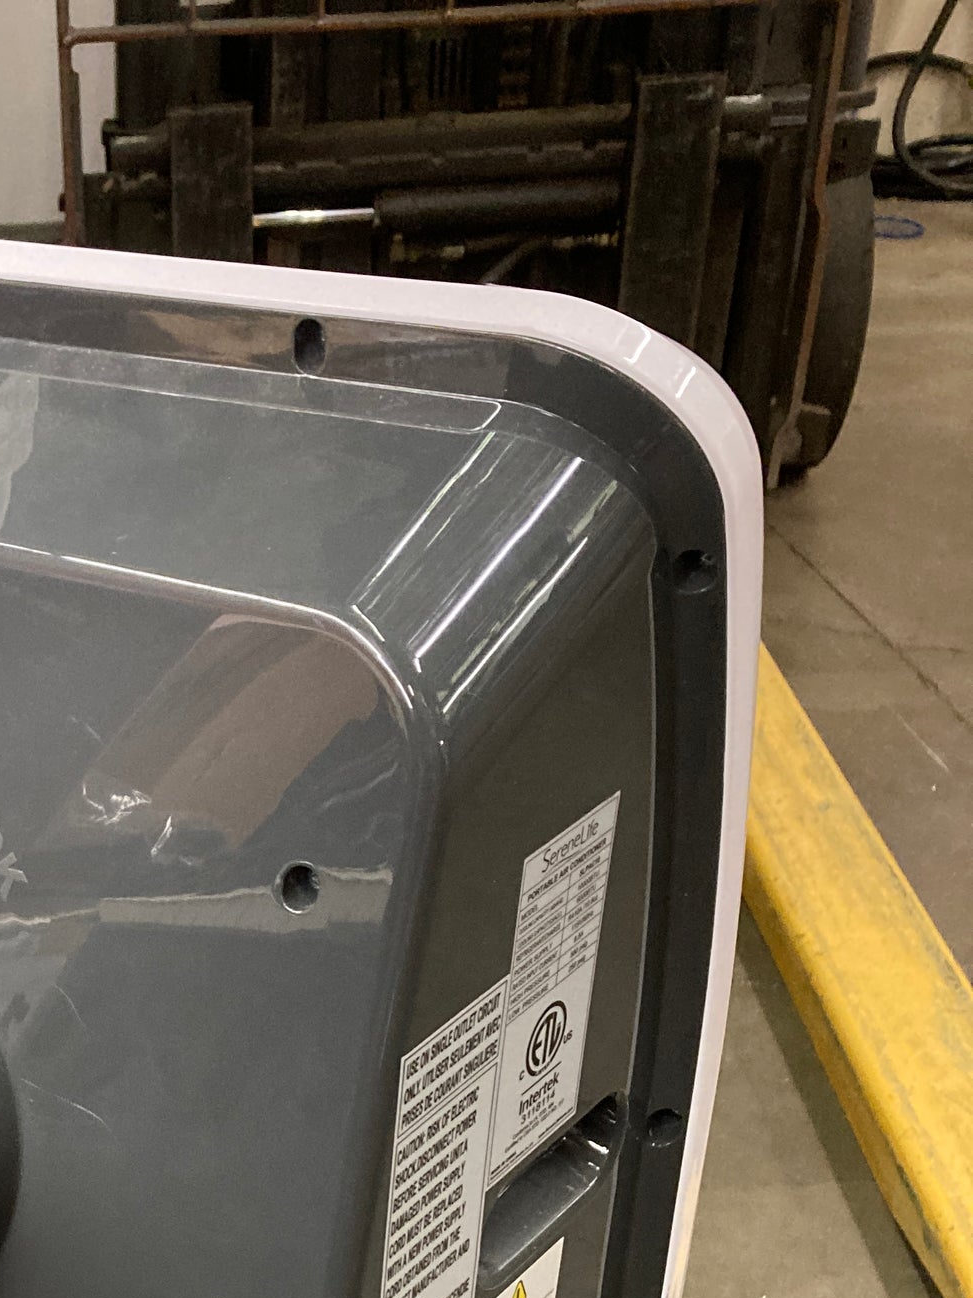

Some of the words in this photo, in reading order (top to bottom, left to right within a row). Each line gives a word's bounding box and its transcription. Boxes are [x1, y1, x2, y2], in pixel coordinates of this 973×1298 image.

[527, 873, 557, 901] PORTABLE
[558, 866, 568, 878] AIR
[569, 837, 606, 869] CONDITIONER
[541, 819, 598, 872] SereneLife
[514, 958, 532, 975] POWER
[533, 943, 552, 961] SUPPLY
[523, 970, 549, 993] PRESSURE
[522, 983, 548, 1008] PRESSURE
[406, 1056, 419, 1079] USE
[420, 1050, 429, 1068] ON
[430, 1030, 452, 1060] SINGLE
[453, 1011, 476, 1041] OUTLET
[477, 992, 500, 1022] CIRCUIT
[422, 1056, 449, 1089] UTILISER
[449, 1027, 484, 1067] SEULEMENT
[484, 1014, 501, 1038] AVEC
[563, 1029, 572, 1044] US
[401, 1099, 423, 1128] PRISES
[424, 1091, 433, 1111] DE
[433, 1067, 462, 1102] COURANT
[426, 1119, 440, 1139] RISK
[441, 1109, 450, 1128] OF
[450, 1086, 479, 1120] ELECTRIC
[518, 1072, 559, 1114] Intertek
[520, 1089, 555, 1124] 3118114
[455, 1109, 476, 1138] POWER
[390, 1200, 420, 1236] DAMAGED
[420, 1181, 442, 1209] POWER
[442, 1161, 465, 1191] SUPPLY
[392, 1181, 417, 1213] BEFORE
[418, 1154, 448, 1191] SERVICING
[387, 1258, 401, 1280] WITH
[402, 1253, 406, 1267] A
[408, 1241, 421, 1261] NEW
[422, 1221, 443, 1249] POWER
[443, 1201, 466, 1231] SUPPLY
[388, 1233, 405, 1258] CORD
[406, 1218, 423, 1243] MUST
[423, 1210, 432, 1228] BE
[432, 1184, 462, 1219] REPLACED
[403, 1252, 431, 1287] OBTAINED
[432, 1237, 448, 1259] FROM
[449, 1225, 460, 1245] THE
[411, 1249, 456, 1298] MANUFACTURER
[457, 1238, 469, 1257] AND
